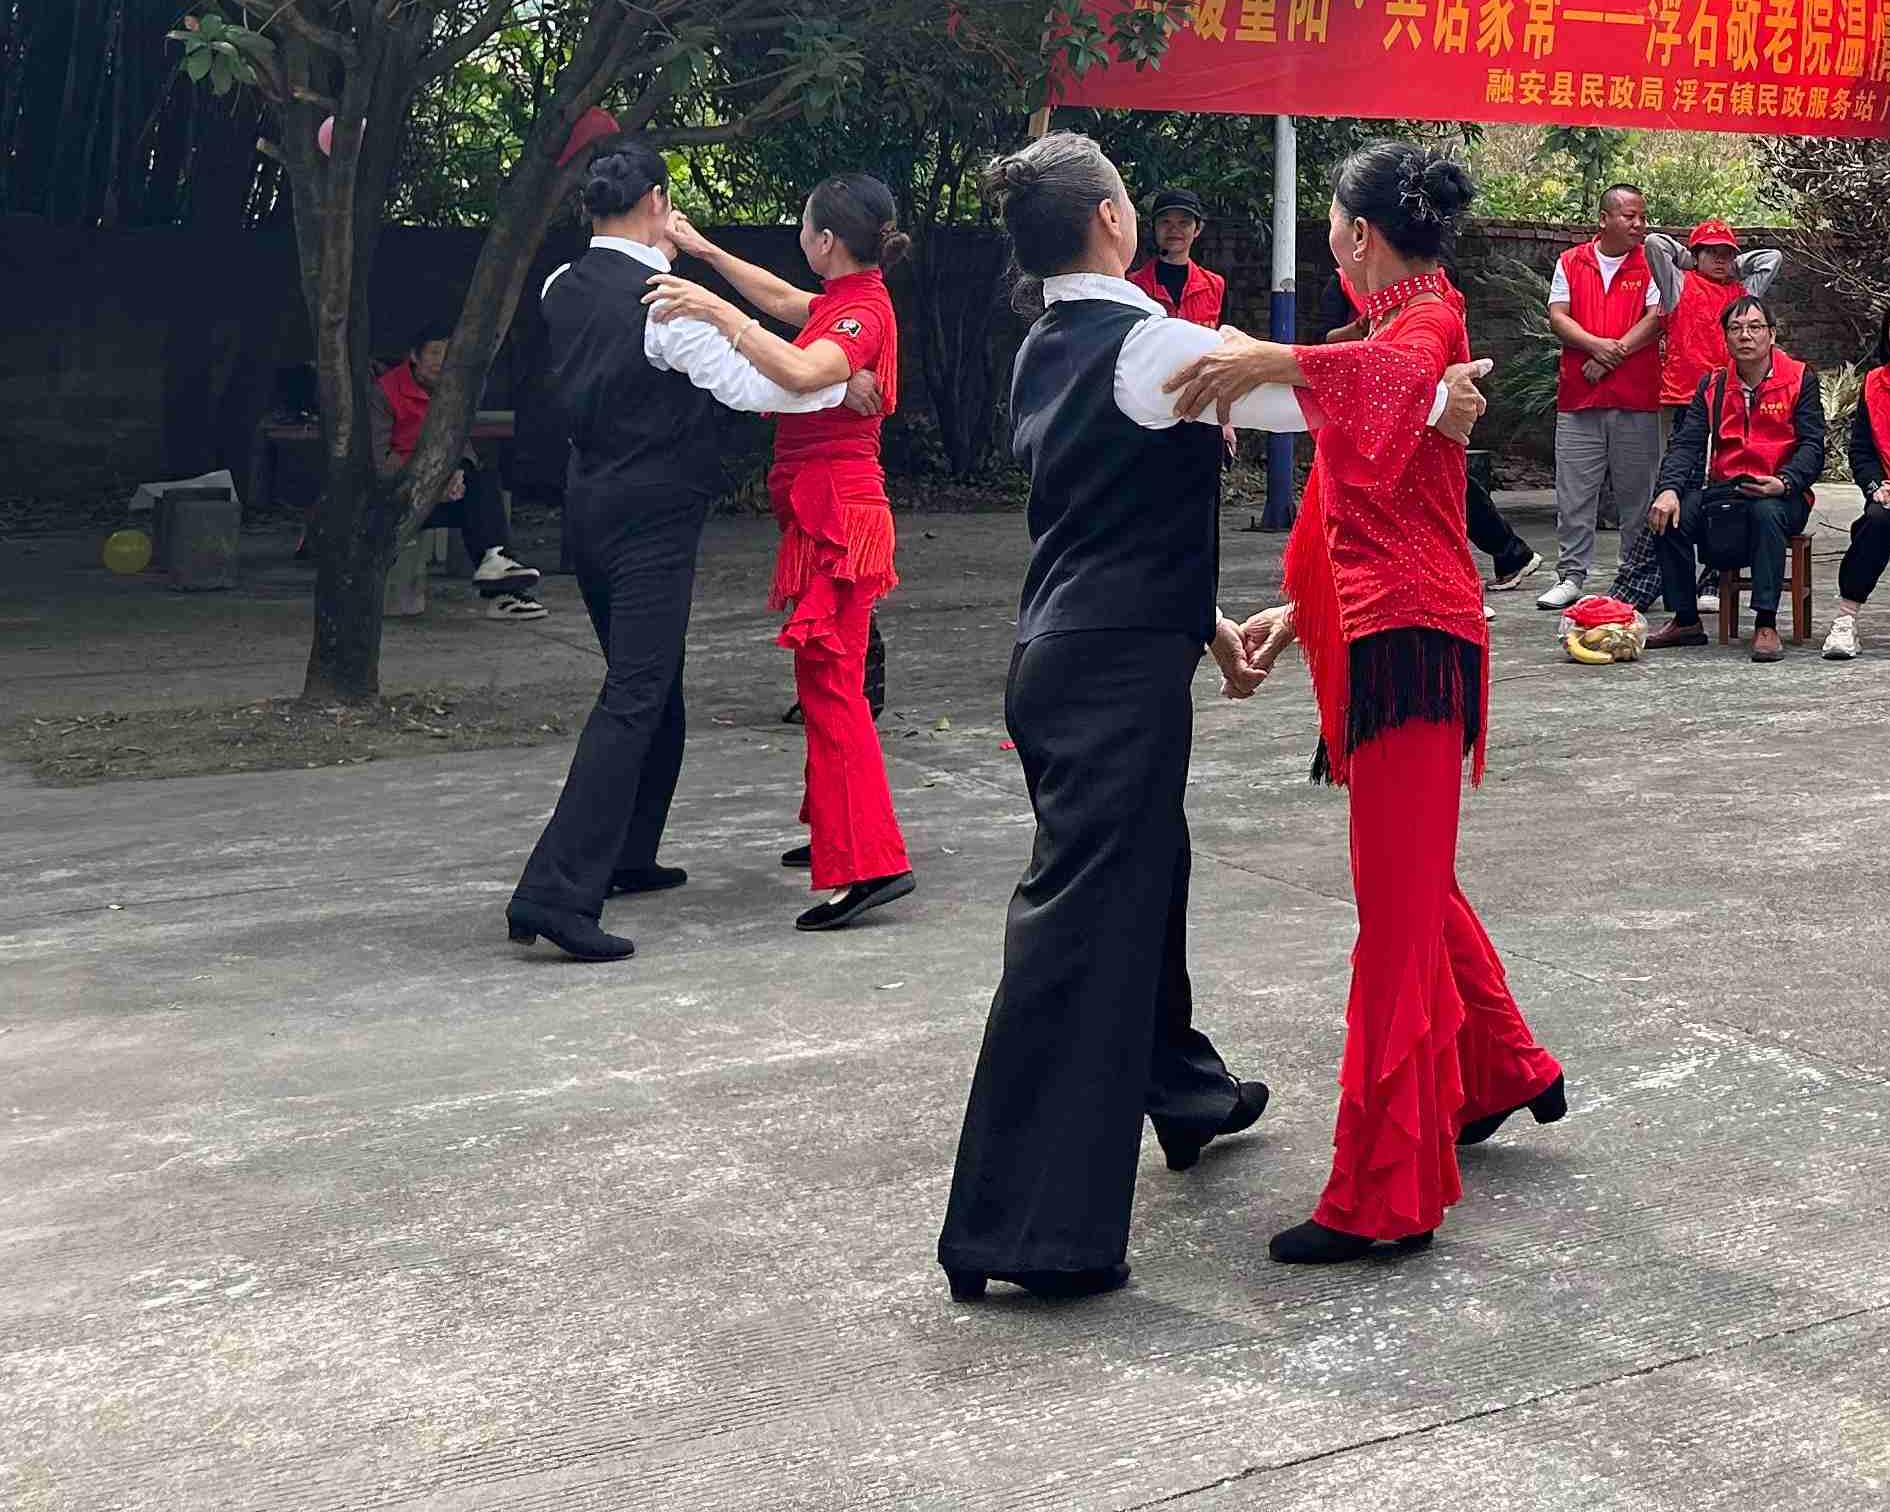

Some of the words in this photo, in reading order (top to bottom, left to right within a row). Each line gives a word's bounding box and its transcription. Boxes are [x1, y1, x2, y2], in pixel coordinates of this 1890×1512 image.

[1486, 68, 1663, 112] 融安县民政局
[1674, 79, 1875, 123] 浮石镇民政服务站
